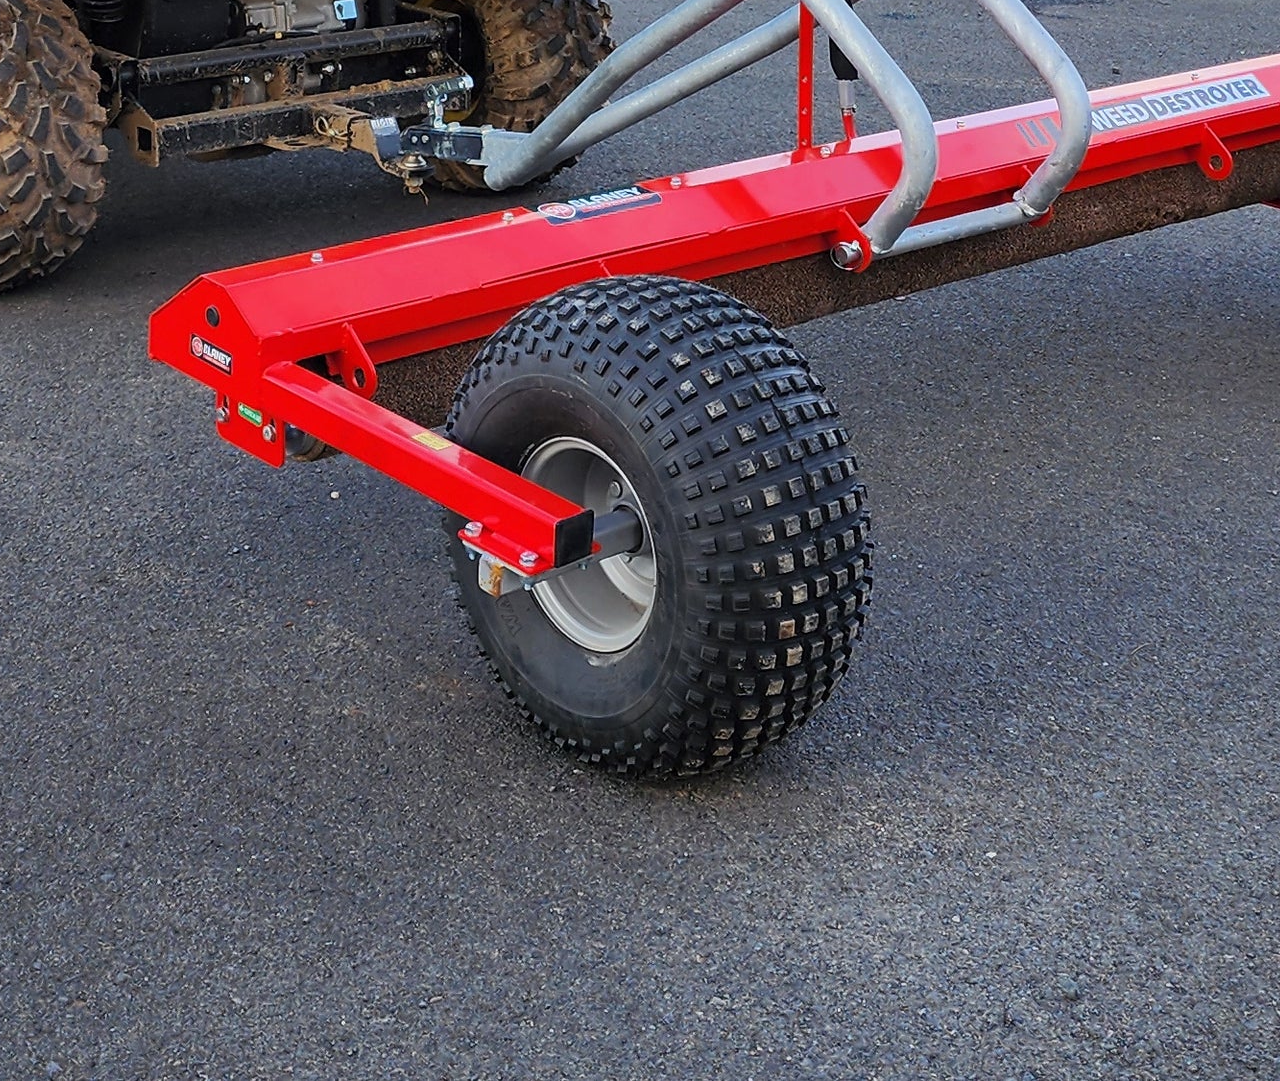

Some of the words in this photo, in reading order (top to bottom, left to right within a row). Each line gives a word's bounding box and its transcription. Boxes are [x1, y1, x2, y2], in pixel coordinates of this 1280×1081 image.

[1150, 78, 1265, 116] DESTROYER
[567, 187, 642, 208] BLANEY
[203, 343, 232, 366] BLANEY
